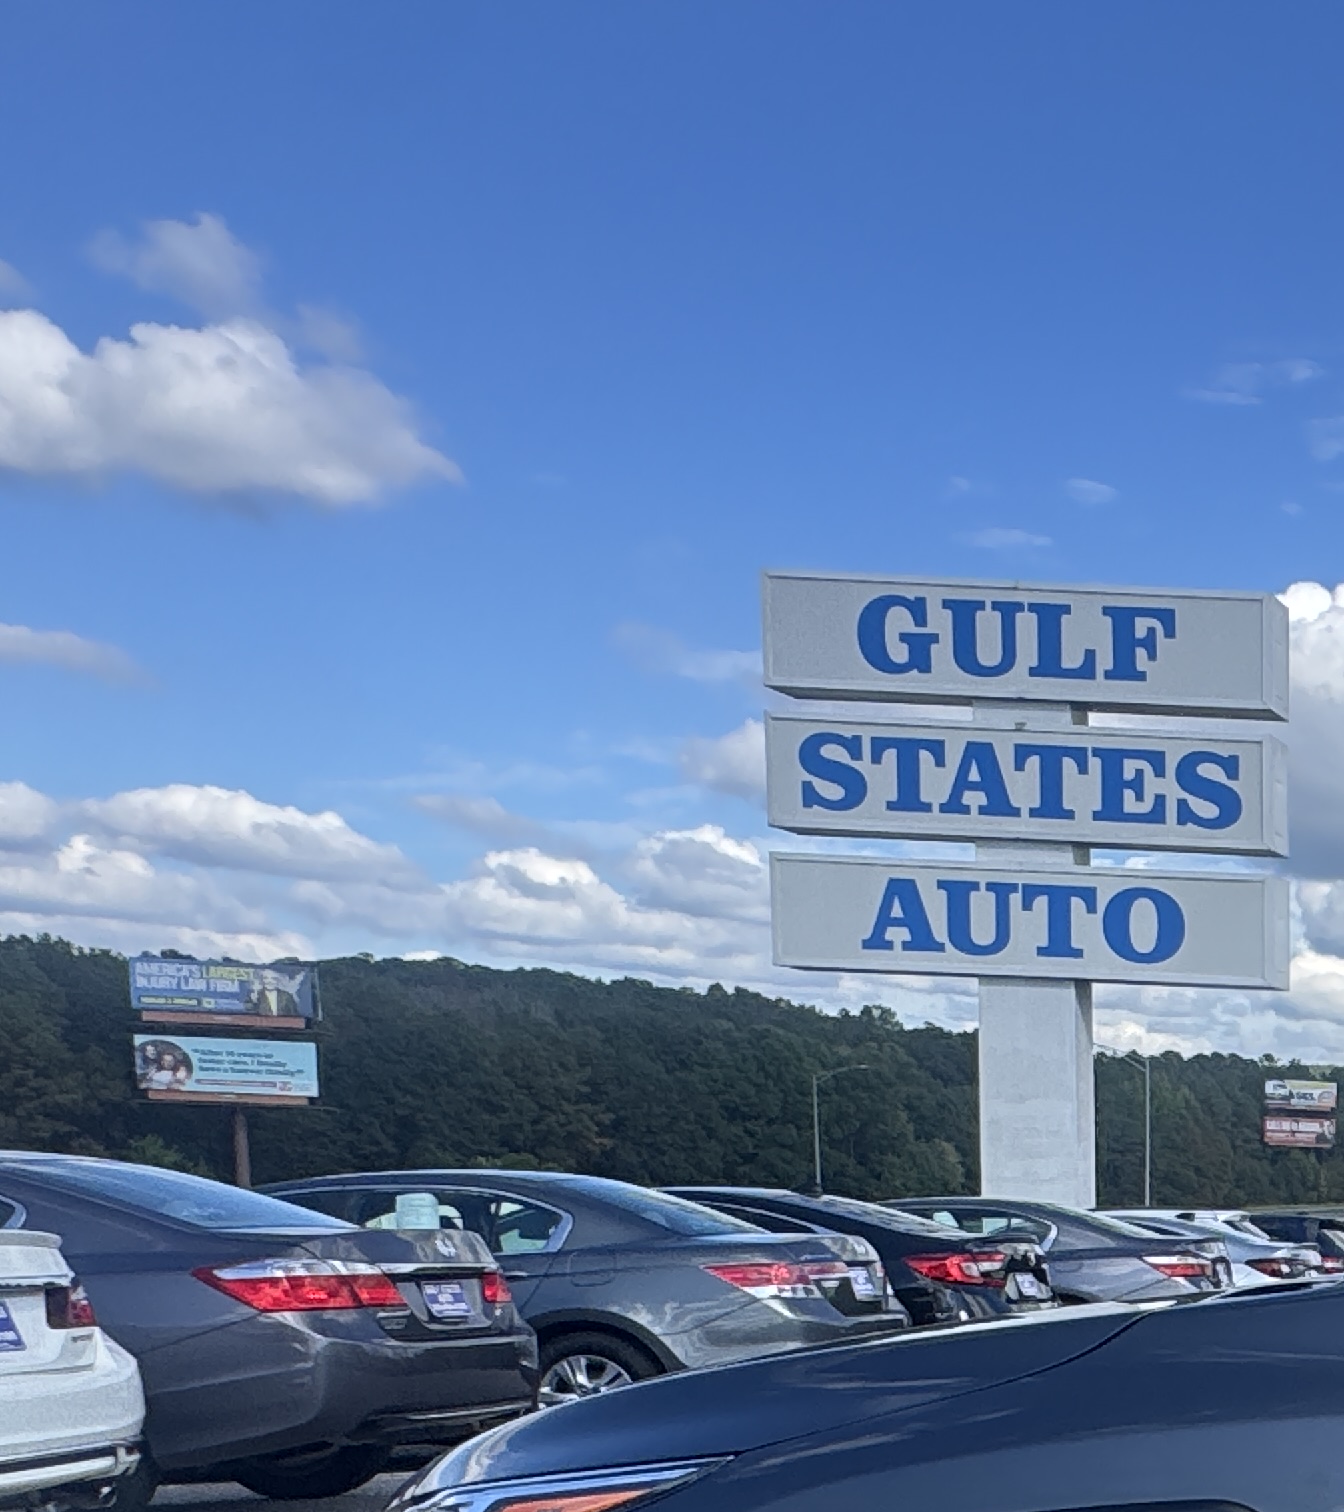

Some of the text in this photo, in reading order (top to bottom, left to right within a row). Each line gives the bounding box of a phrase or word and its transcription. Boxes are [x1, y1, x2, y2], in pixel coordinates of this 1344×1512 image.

[857, 594, 1176, 681] GULF
[799, 732, 1242, 830] STATES
[862, 877, 1185, 964] AUTO
[181, 976, 207, 991] LAW
